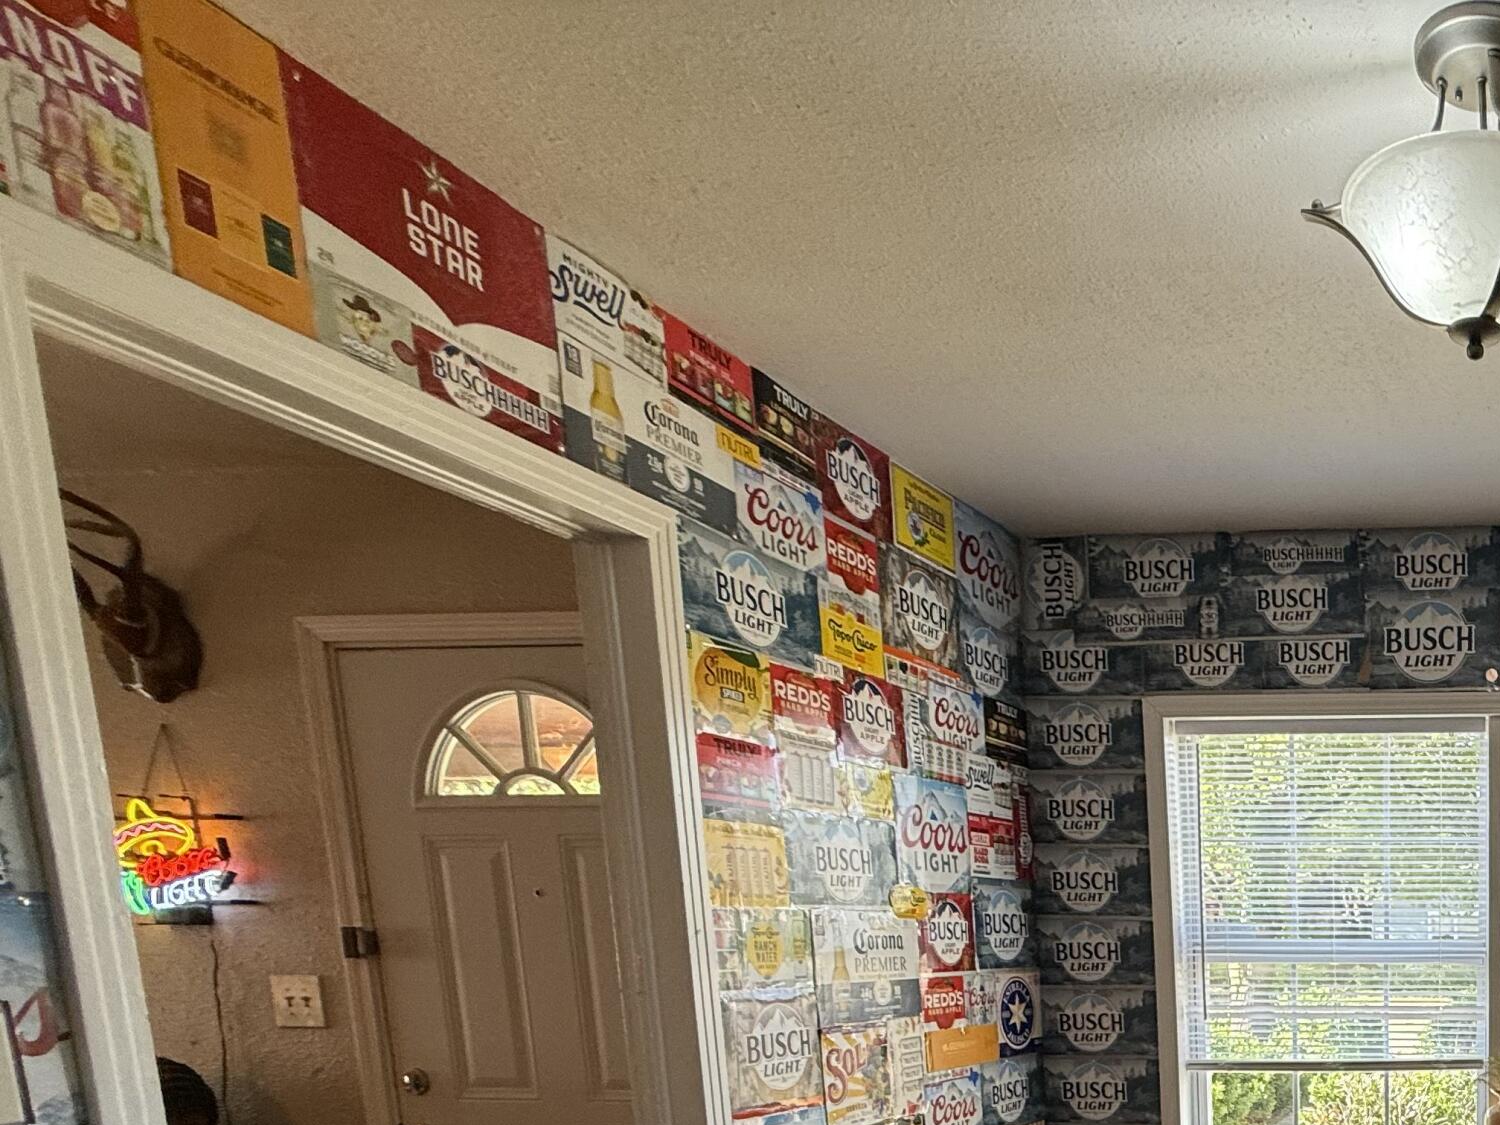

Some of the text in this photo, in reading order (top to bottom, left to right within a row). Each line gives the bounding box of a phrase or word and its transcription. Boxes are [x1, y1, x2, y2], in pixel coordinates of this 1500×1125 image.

[0, 6, 138, 111] NOFF
[402, 187, 479, 260] LONE
[407, 223, 485, 292] STAR
[562, 252, 610, 288] MIGHTY
[549, 264, 627, 323] Swell
[687, 328, 732, 368] TRULY
[774, 384, 809, 419] TRULY
[644, 400, 699, 446] Corona
[646, 425, 703, 466] PREMIER
[827, 451, 880, 506] BUSCH
[745, 482, 818, 550] Coors
[761, 530, 808, 567] LIGHT
[826, 541, 877, 574] REDD'S
[958, 530, 1019, 599] Coors
[1125, 559, 1193, 581] BUSCH
[972, 580, 1011, 611] LIGHT
[1042, 544, 1064, 618] BUSCH
[1064, 561, 1074, 603] LIGHT
[1140, 582, 1180, 593] LIGHT
[715, 570, 787, 626] BUSCH
[899, 587, 948, 631] BUSCH
[1257, 587, 1327, 610] BUSCH
[735, 609, 773, 635] LIGHT
[912, 619, 938, 638] LIGHT
[1272, 610, 1313, 621] LIGHT
[1386, 626, 1473, 653] BUSCH
[965, 643, 1008, 680] BUSCH
[1175, 644, 1243, 665] BUSCH
[1405, 654, 1456, 667] LIGHT
[704, 655, 757, 701] Simply
[976, 670, 1000, 687] LIGHT
[1190, 666, 1229, 676] LIGHT
[774, 681, 831, 711] REDD'S
[844, 697, 894, 731] BUSCH
[934, 696, 981, 738] Coors
[1050, 800, 1114, 820] BUSCH
[902, 804, 967, 854] Coors
[1063, 820, 1101, 830] LIGHT
[816, 846, 871, 875] BUSCH
[915, 853, 959, 874] LIGHT
[830, 876, 863, 888] LIGHT
[930, 921, 969, 942] BUSCH
[985, 913, 1027, 937] BUSCH
[854, 927, 905, 954] Corona
[995, 938, 1020, 949] LIGHT
[855, 956, 908, 972] PREMIER
[925, 990, 964, 1008] REDD'S
[1060, 1013, 1124, 1033] BUSCH
[1074, 1032, 1112, 1042] LIGHT
[747, 1029, 811, 1064] BUSCH
[764, 1060, 801, 1078] LIGHT
[992, 1080, 1028, 1105] BUSCH
[931, 1095, 976, 1125] Coors
[1001, 1102, 1022, 1114] LIGHT
